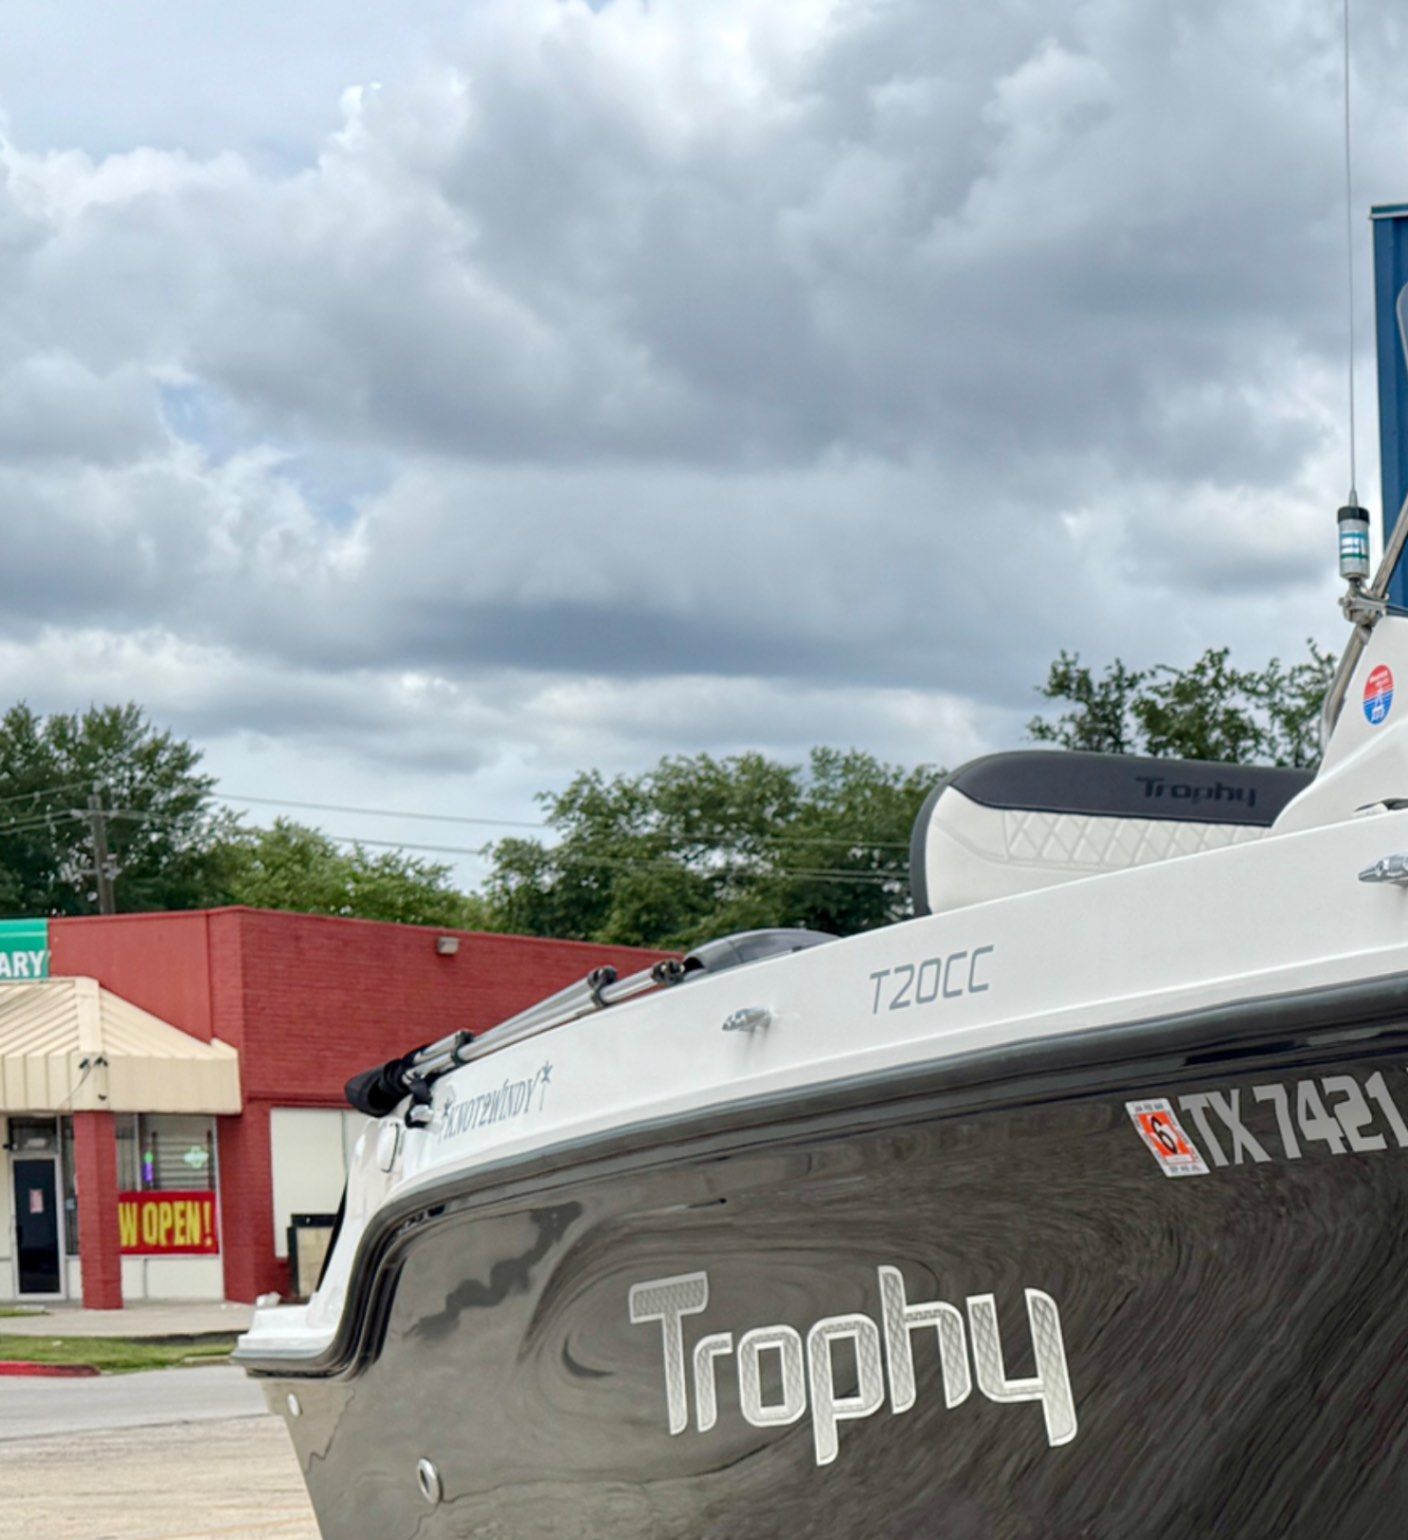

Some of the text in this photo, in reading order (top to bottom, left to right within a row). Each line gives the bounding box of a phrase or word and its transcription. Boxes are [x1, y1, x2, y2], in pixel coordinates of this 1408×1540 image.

[1135, 775, 1257, 808] Trophy
[869, 944, 994, 1014] T20CC
[1178, 1087, 1272, 1167] TX
[142, 1201, 212, 1247] OPEN!
[628, 1265, 1077, 1466] Trophy
